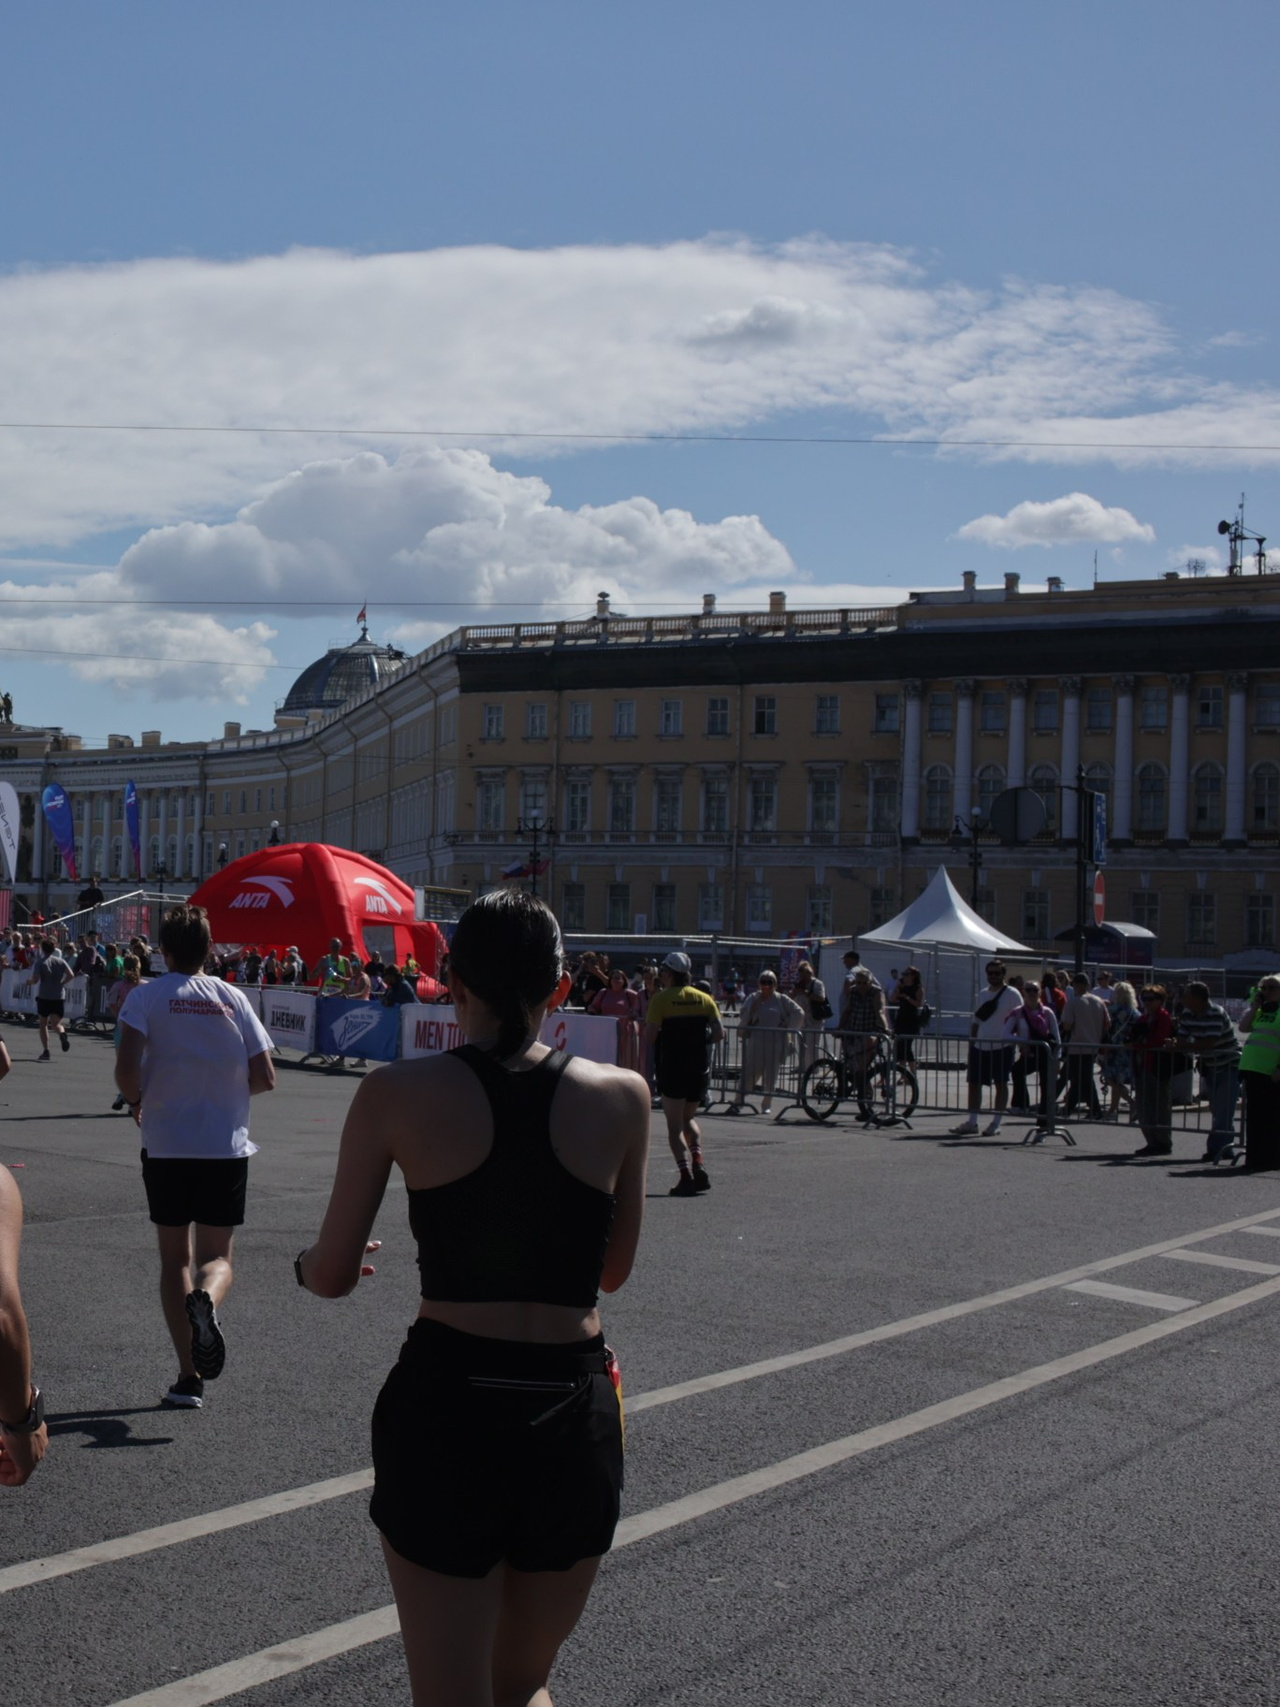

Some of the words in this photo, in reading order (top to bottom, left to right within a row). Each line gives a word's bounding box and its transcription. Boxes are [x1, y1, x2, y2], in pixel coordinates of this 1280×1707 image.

[228, 892, 271, 909] ANTA
[366, 894, 388, 914] ANTA
[414, 1020, 444, 1051] MEN
